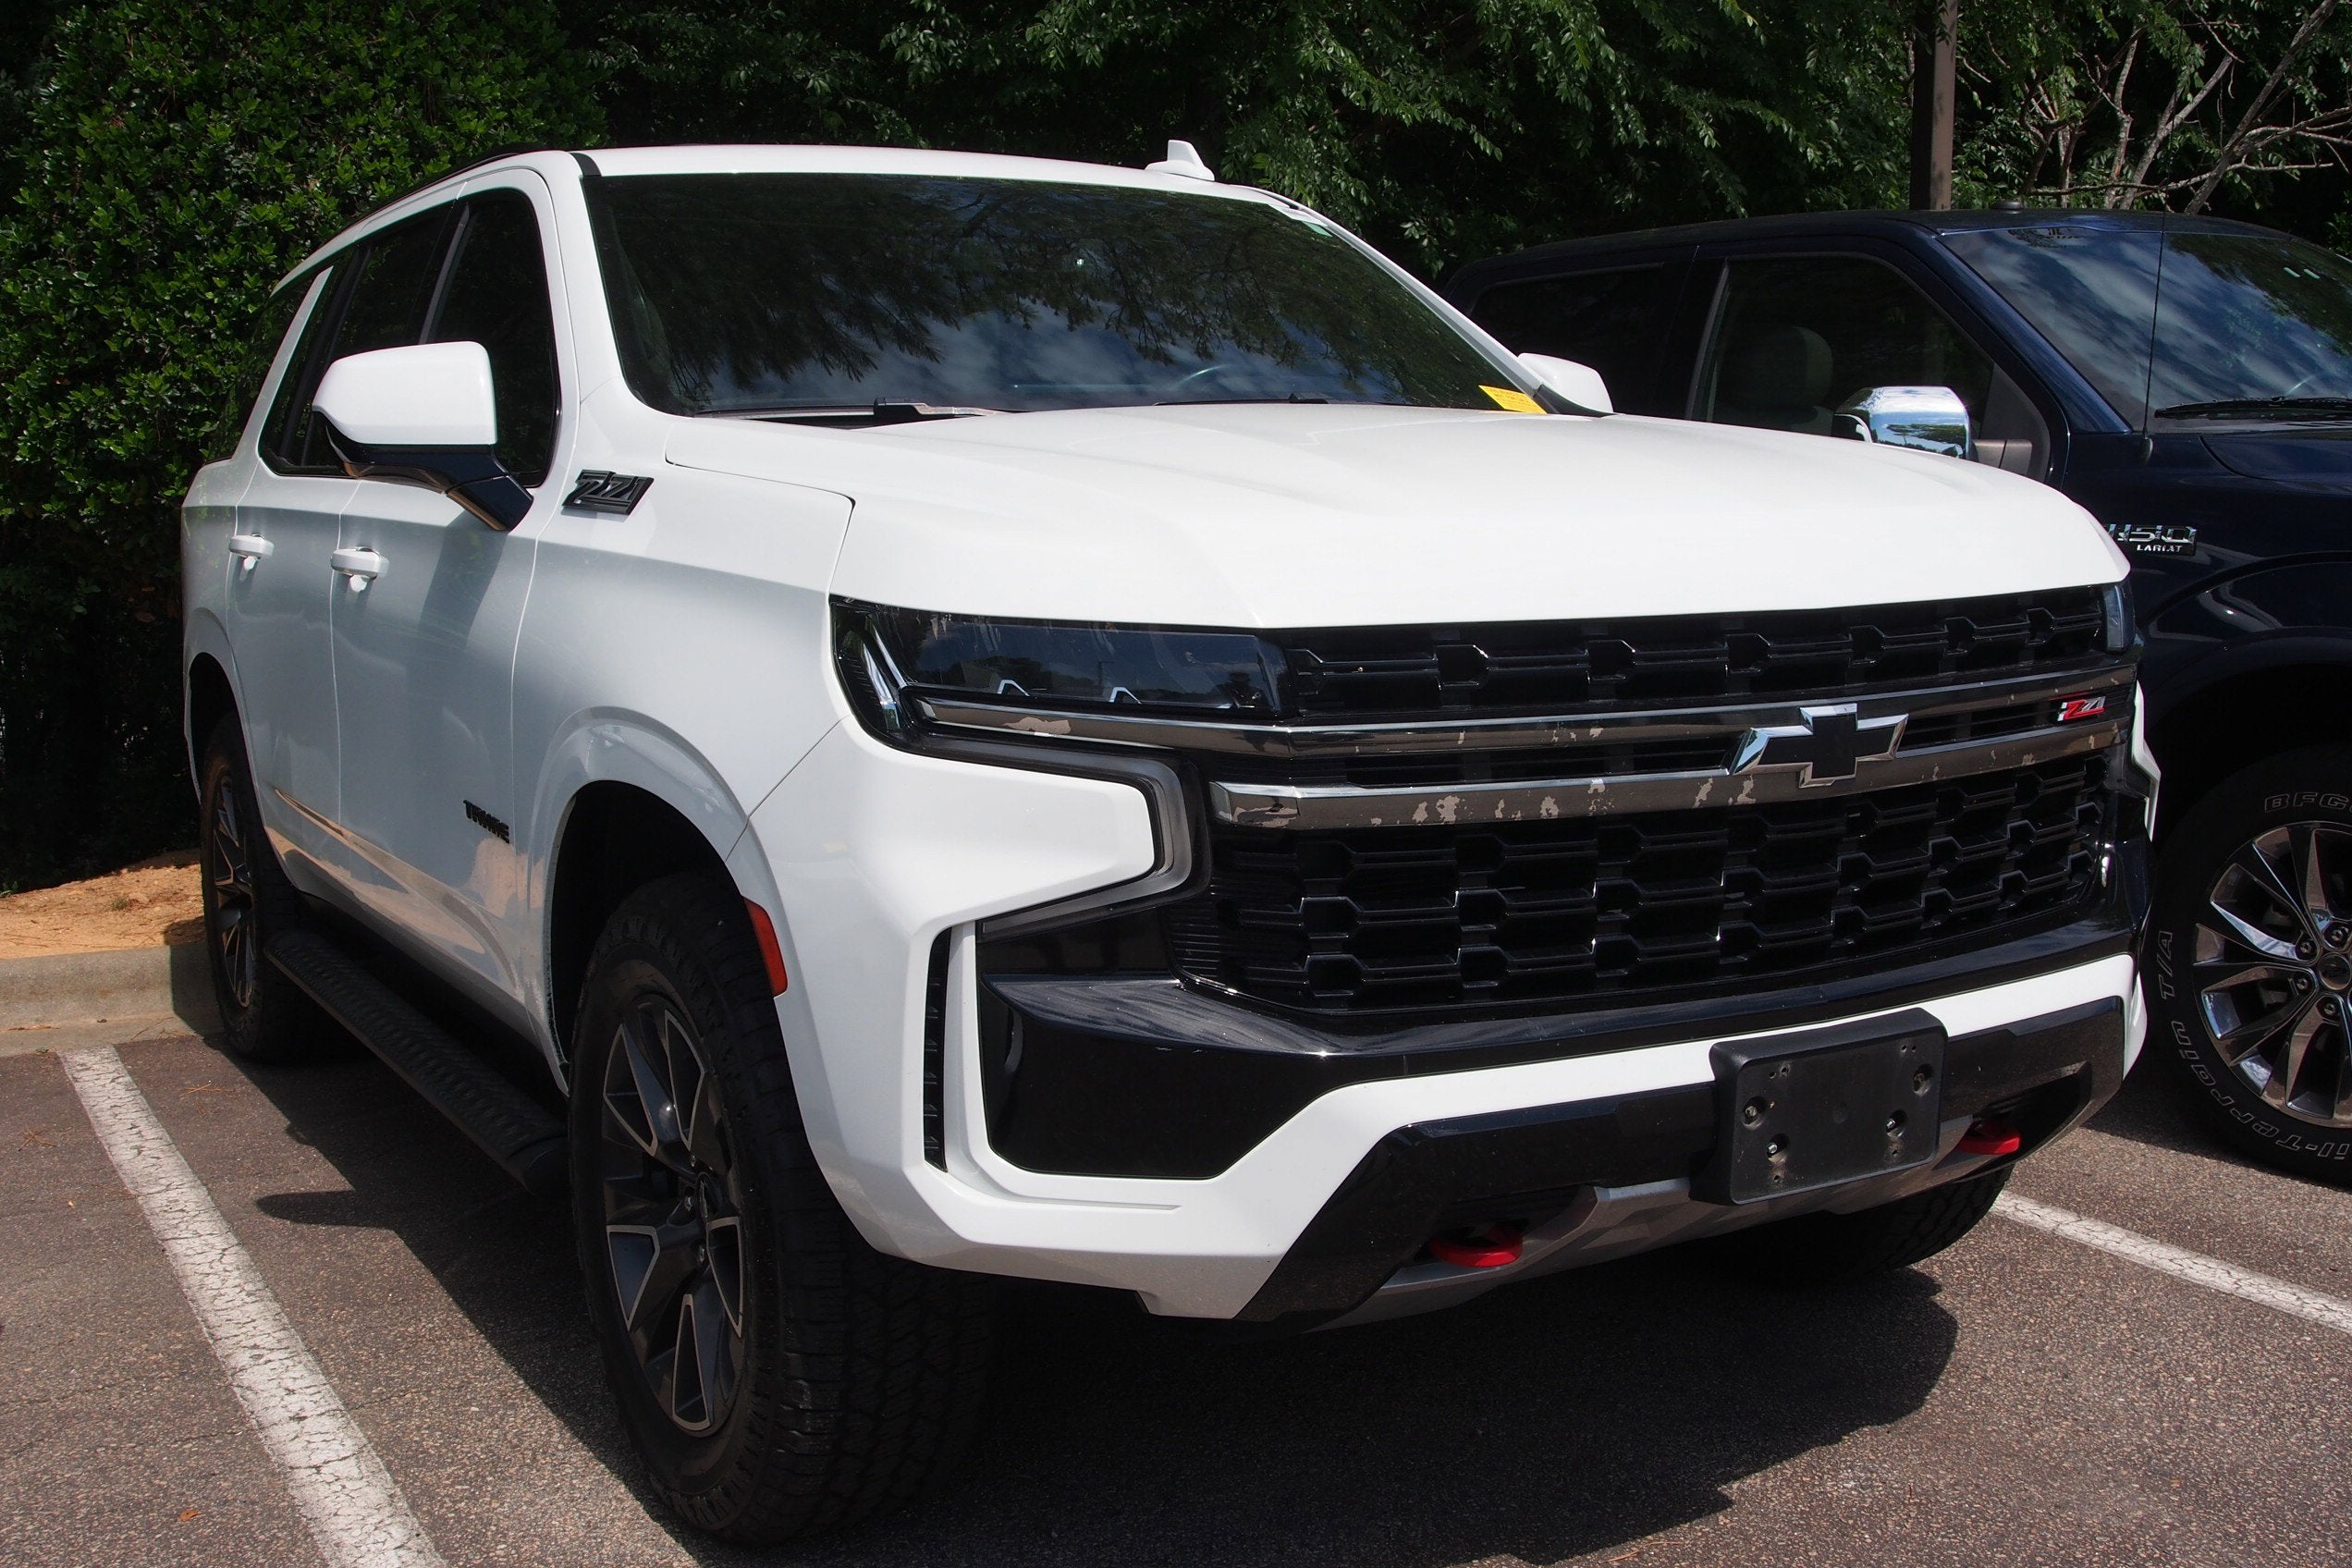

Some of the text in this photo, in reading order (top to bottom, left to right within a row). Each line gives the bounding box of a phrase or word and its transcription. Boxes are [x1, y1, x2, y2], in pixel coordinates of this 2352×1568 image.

[2107, 523, 2198, 545] 150
[2137, 544, 2183, 552] LARIAT
[2263, 791, 2352, 814] BFG
[2156, 930, 2175, 1000] T/A
